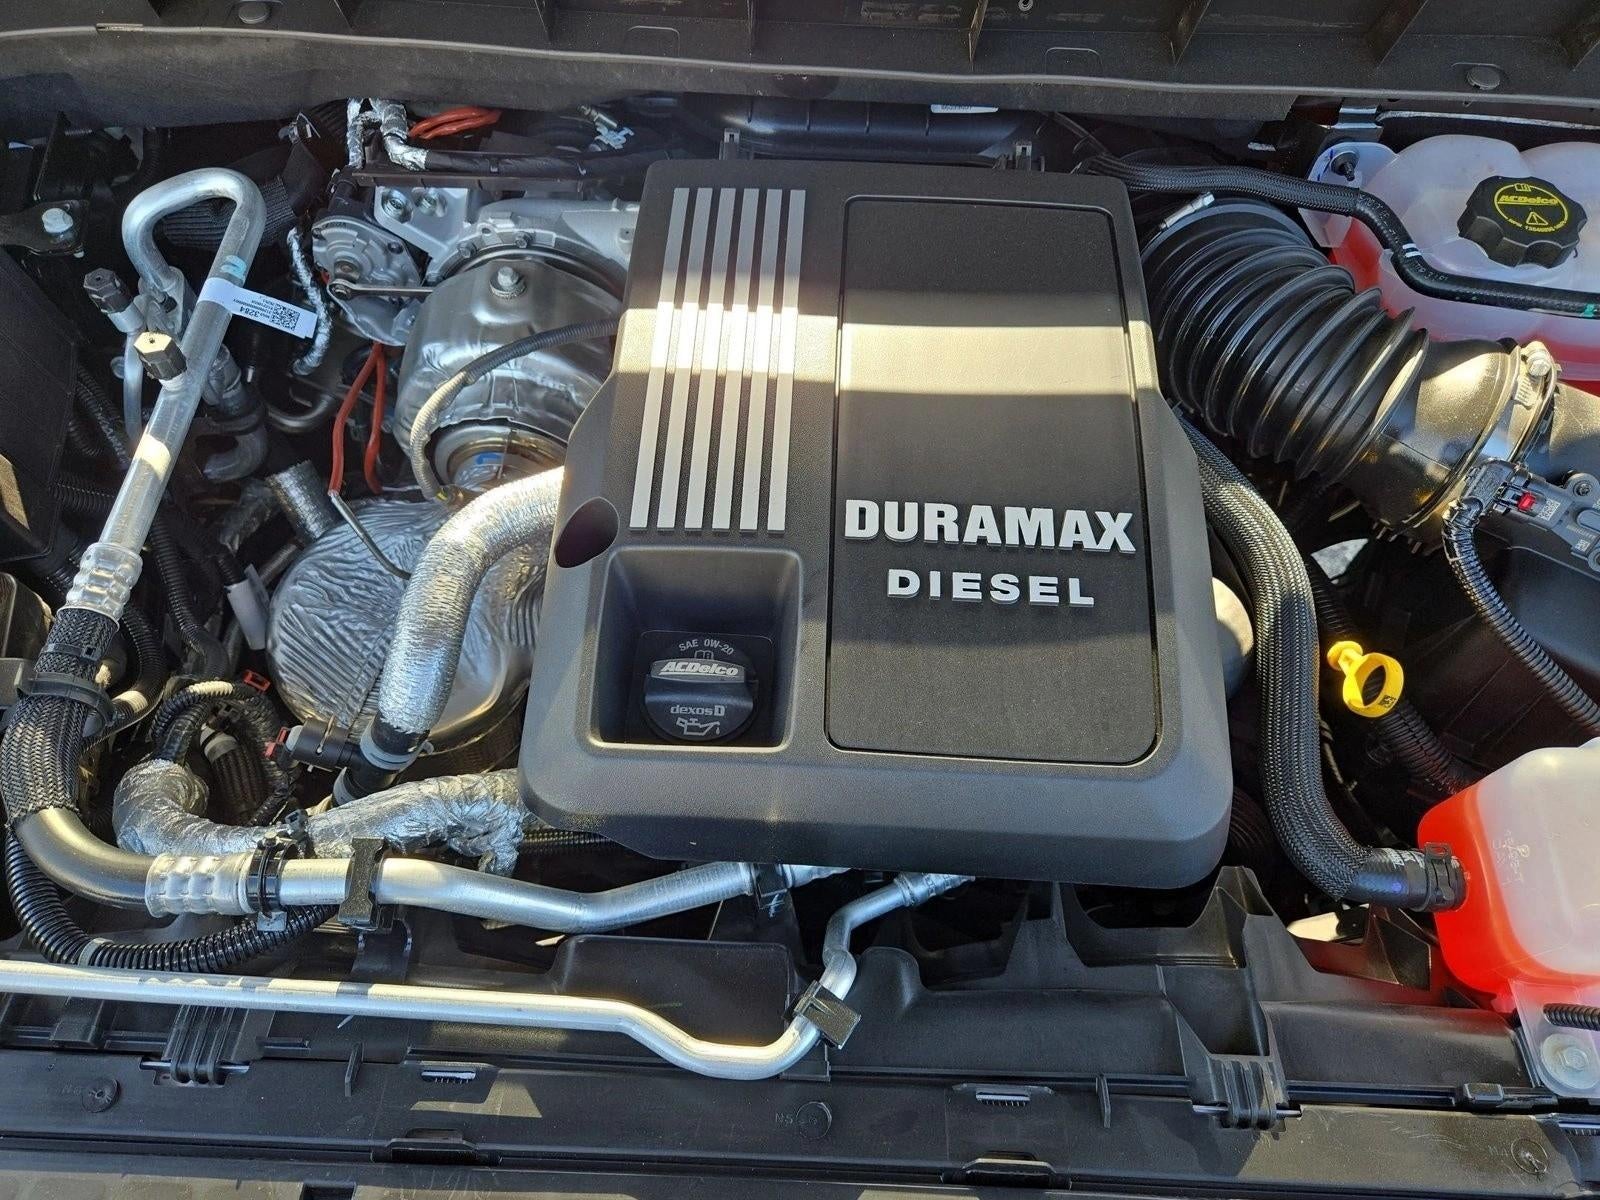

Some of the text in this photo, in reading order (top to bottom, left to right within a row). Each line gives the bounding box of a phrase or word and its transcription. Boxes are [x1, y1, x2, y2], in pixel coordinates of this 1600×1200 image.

[1498, 195, 1558, 206] ACDelco
[844, 499, 1136, 554] DURAMAX
[887, 568, 1094, 607] DIESEL
[678, 638, 735, 656] SAE 0W-20
[658, 661, 739, 677] ACDelco
